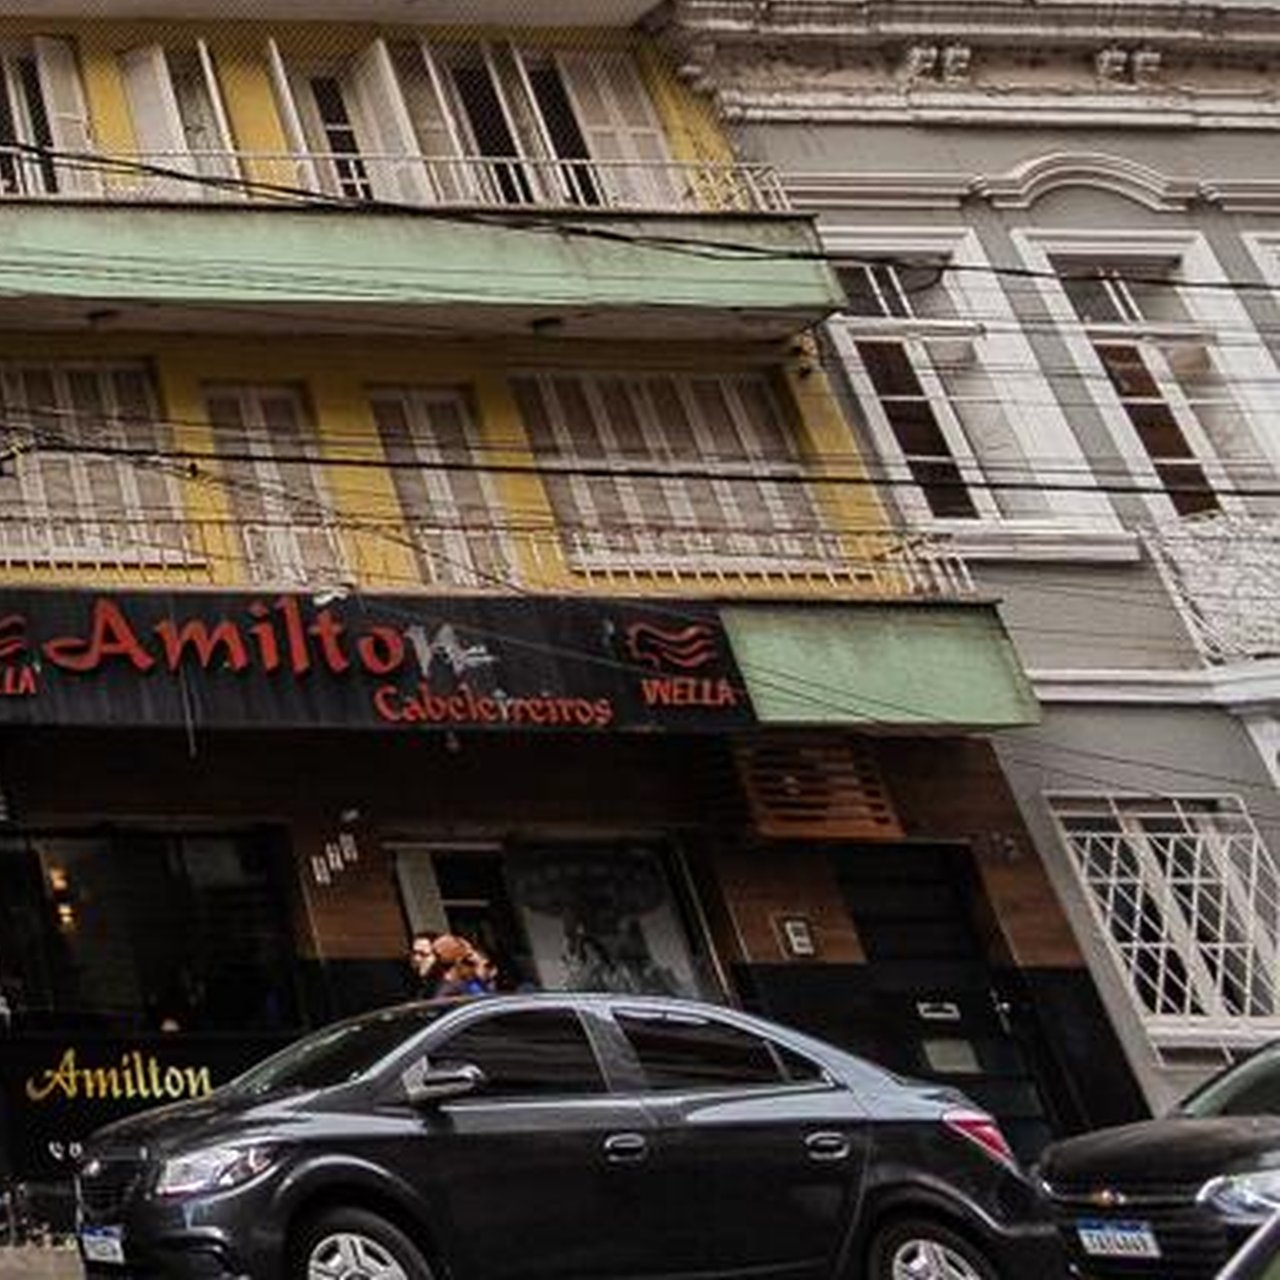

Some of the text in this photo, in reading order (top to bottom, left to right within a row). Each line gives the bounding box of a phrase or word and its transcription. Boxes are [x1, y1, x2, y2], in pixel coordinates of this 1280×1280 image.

[45, 596, 486, 676] Amilton
[640, 676, 737, 706] WELLA
[26, 1047, 216, 1100] Amilton
